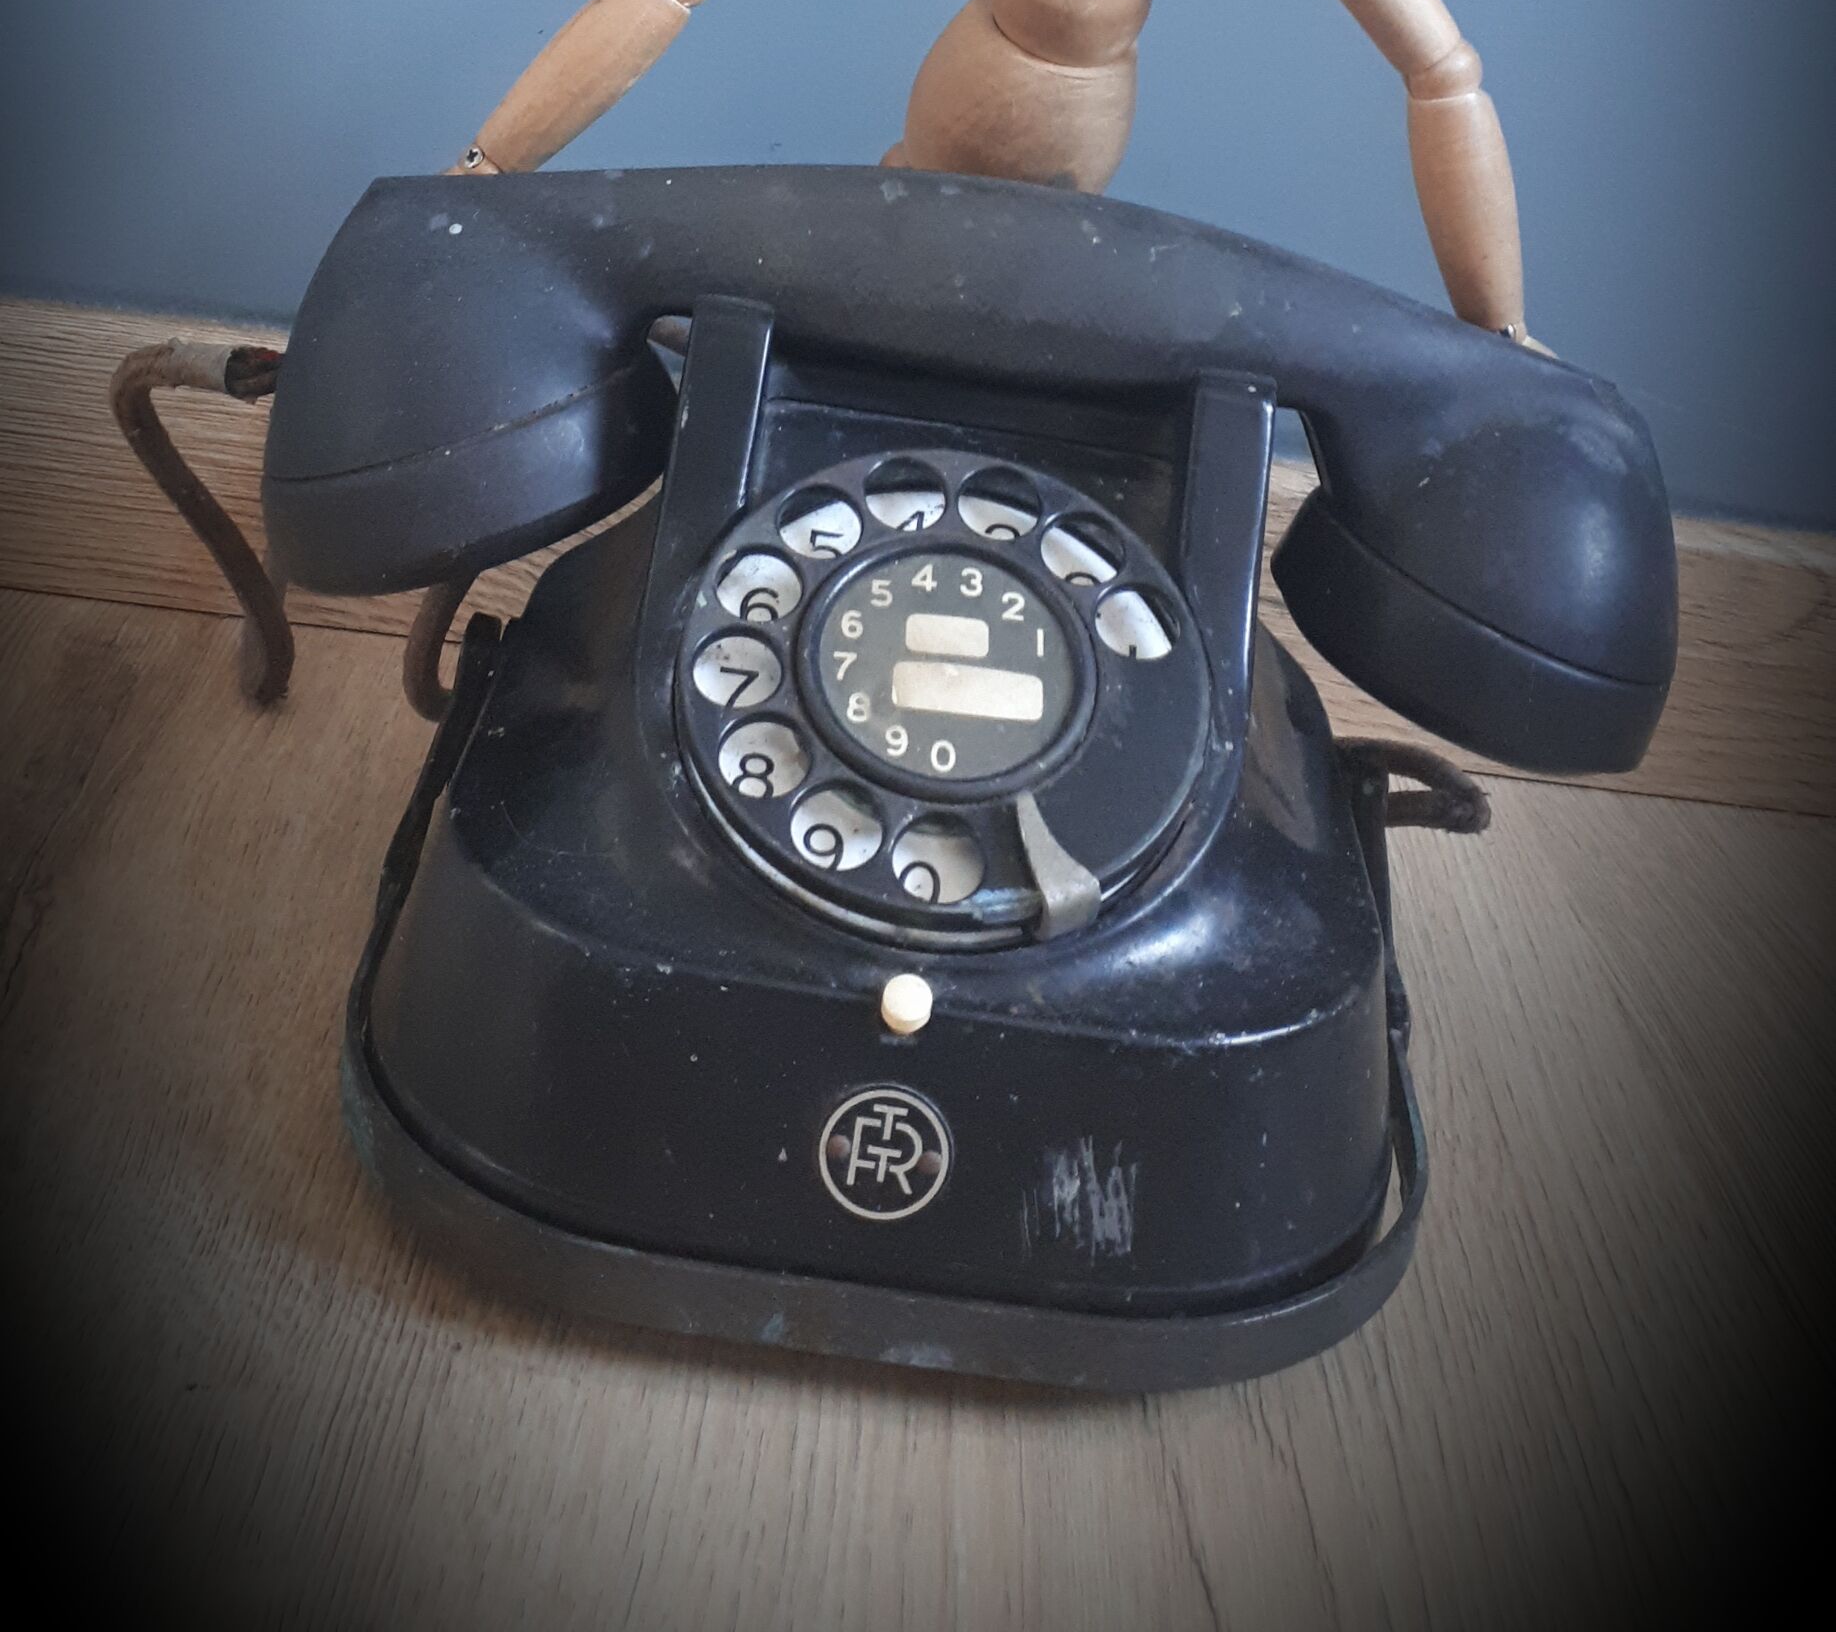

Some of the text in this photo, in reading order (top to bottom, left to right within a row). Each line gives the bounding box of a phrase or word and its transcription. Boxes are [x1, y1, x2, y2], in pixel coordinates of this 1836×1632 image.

[911, 563, 937, 592] 4
[960, 568, 983, 597] 3
[740, 587, 779, 620] 6
[870, 579, 893, 607] 5
[1001, 592, 1025, 621] 2
[840, 610, 864, 639] 6
[833, 651, 857, 680] 7
[720, 666, 760, 708] 7
[846, 692, 871, 722] 8
[885, 724, 909, 757] 9
[930, 739, 956, 772] 0
[732, 753, 774, 798] 8
[803, 823, 844, 870] 9
